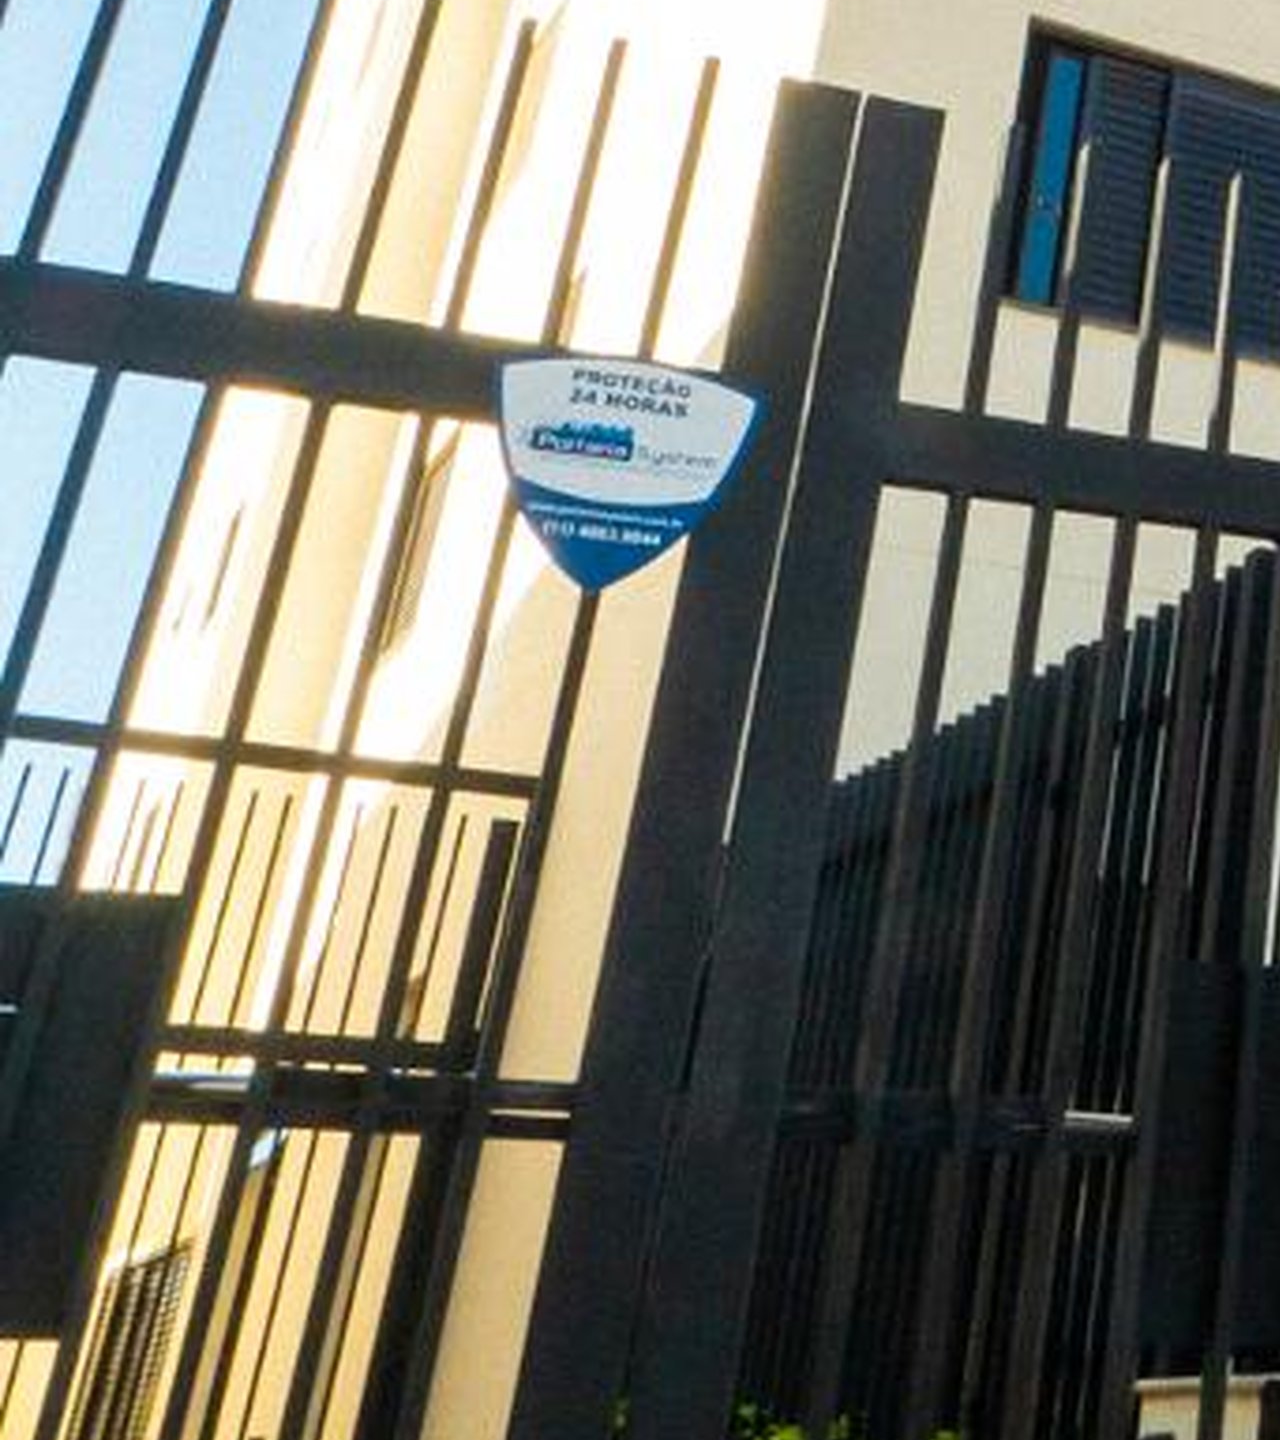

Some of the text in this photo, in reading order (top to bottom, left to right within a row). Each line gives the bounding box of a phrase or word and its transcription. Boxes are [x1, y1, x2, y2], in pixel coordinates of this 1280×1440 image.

[572, 369, 692, 399] PROTEÇÃO
[570, 387, 690, 418] 24 HORAS
